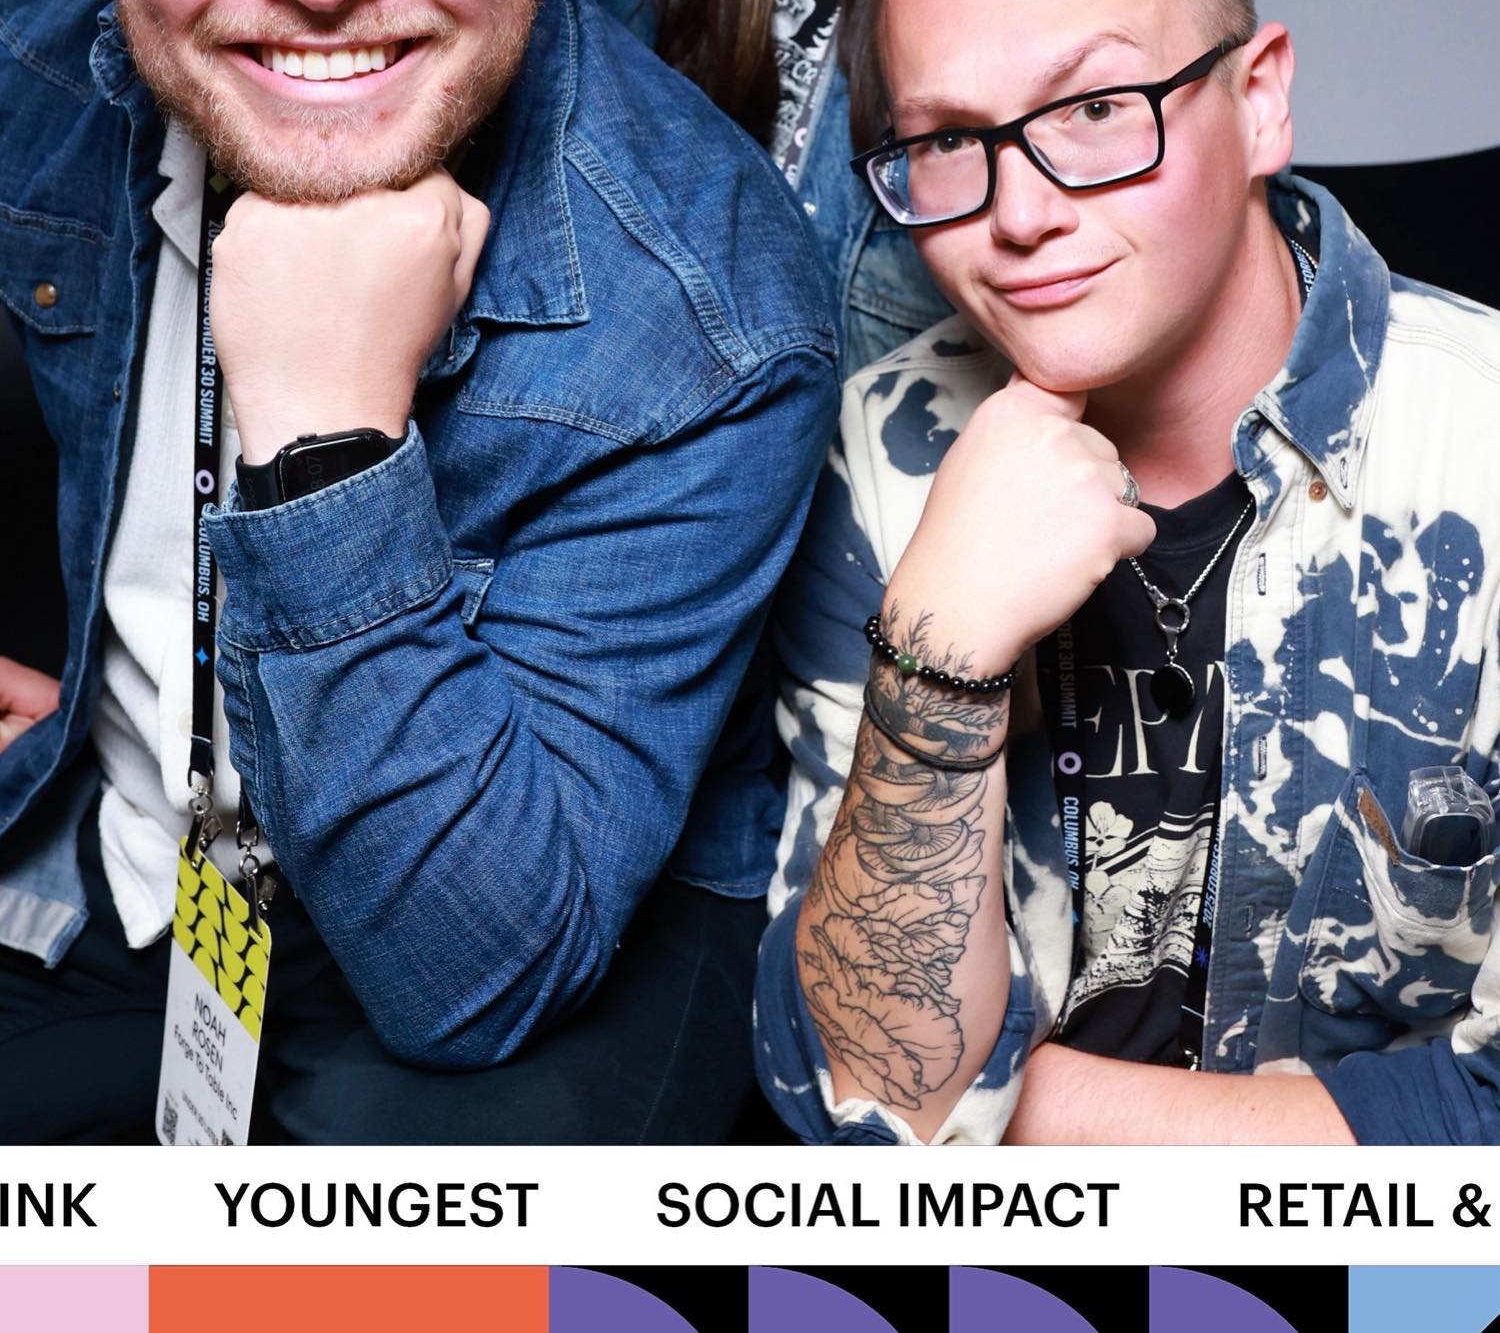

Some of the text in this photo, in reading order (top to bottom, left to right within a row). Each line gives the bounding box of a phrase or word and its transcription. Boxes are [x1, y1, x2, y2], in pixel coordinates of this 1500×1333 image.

[200, 367, 216, 387] 30
[199, 388, 214, 447] SUMMIT
[197, 601, 210, 623] OH
[1060, 673, 1077, 728] SUMMIT
[192, 1020, 224, 1072] ROSEN
[194, 992, 227, 1047] NOAH
[174, 1024, 238, 1120] Forge To Table Inc
